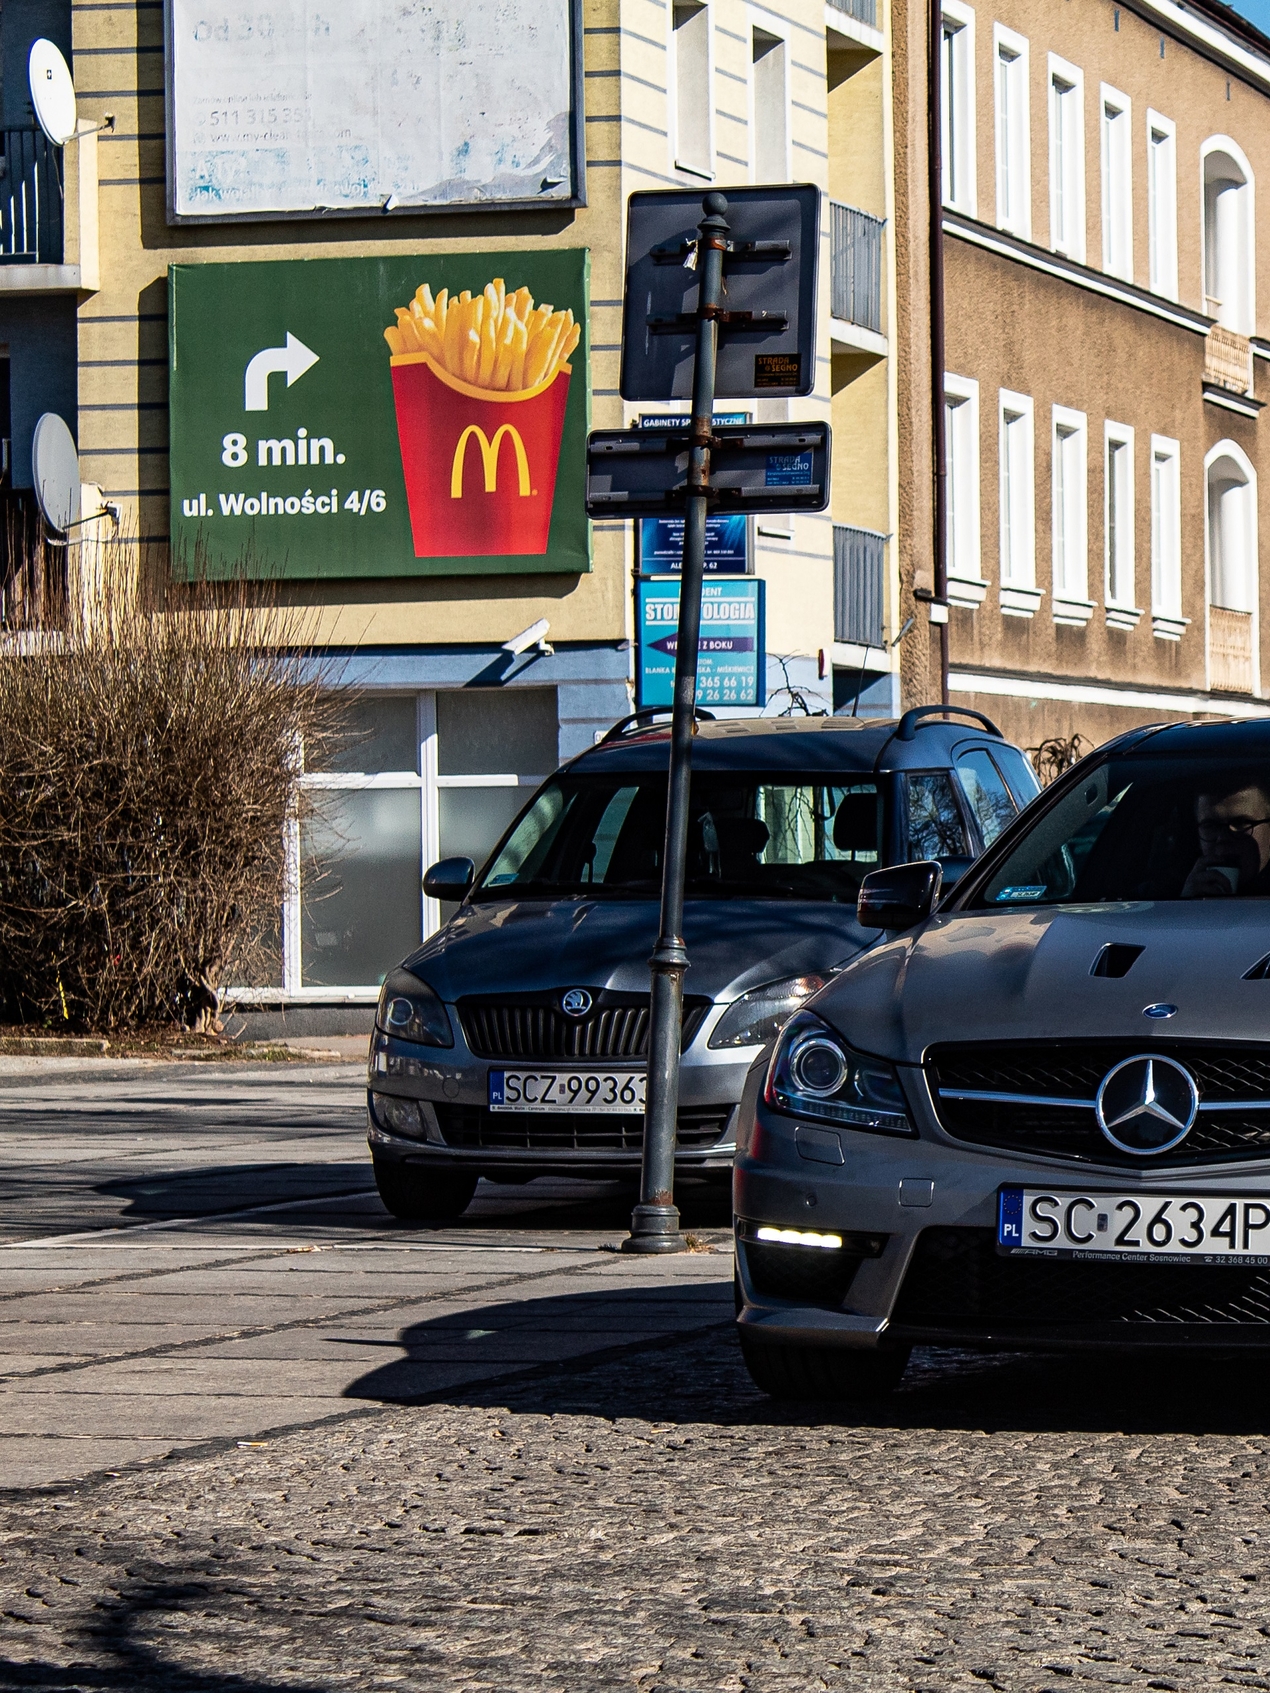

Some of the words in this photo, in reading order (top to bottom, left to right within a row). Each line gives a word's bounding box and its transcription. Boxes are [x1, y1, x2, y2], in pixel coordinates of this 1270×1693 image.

[210, 110, 240, 126] 511
[758, 357, 789, 365] STRADA
[643, 418, 680, 427] GABINETY
[221, 432, 248, 467] 8
[257, 427, 346, 466] min.
[182, 493, 214, 517] ul.
[219, 488, 338, 516] Wolności
[344, 489, 387, 515] 4/6
[645, 602, 755, 620] STOOLOGIA
[702, 641, 708, 650] Z
[709, 640, 733, 650] BOKU
[700, 676, 720, 687] 365
[723, 676, 737, 687] 66
[741, 676, 754, 687] 19
[706, 690, 720, 700] 26
[723, 689, 737, 700] 26
[740, 689, 753, 700] 62
[492, 1091, 503, 1100] PL
[505, 1074, 557, 1104] SCZ
[1028, 1195, 1097, 1245] SC
[1003, 1223, 1019, 1237] PL
[1024, 1248, 1058, 1256] AMG
[1072, 1250, 1120, 1261] Performance
[1121, 1253, 1148, 1262] Center
[1149, 1253, 1191, 1263] Sosnowiec
[1215, 1256, 1226, 1264] 32
[1227, 1256, 1243, 1264] 368
[1244, 1256, 1256, 1264] 45
[1257, 1256, 1268, 1265] 00
